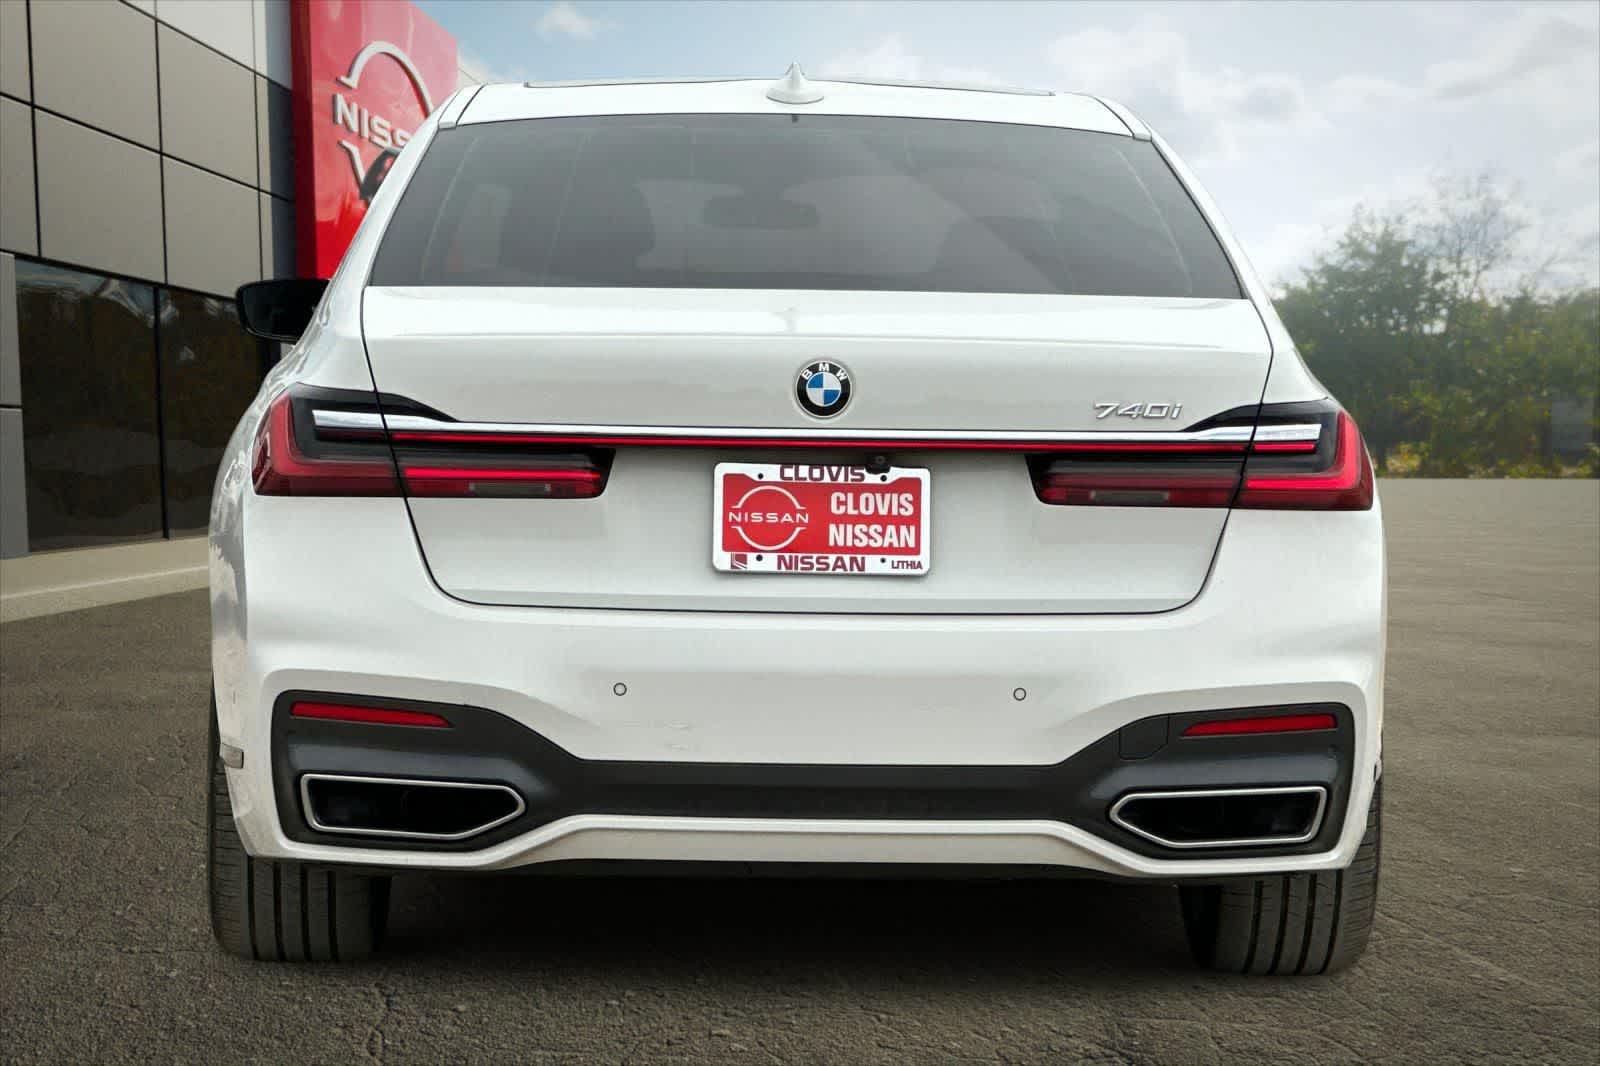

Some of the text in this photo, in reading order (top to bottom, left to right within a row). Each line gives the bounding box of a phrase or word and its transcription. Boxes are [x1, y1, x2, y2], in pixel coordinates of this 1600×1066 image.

[801, 363, 848, 380] BMW
[1095, 402, 1183, 419] 740i
[779, 465, 865, 482] CLOVIS
[830, 492, 914, 516] CLOVIS
[728, 511, 809, 524] NISSAN
[828, 523, 916, 548] NISSAN
[777, 555, 865, 572] NISSAN
[891, 560, 923, 570] LITHIA
